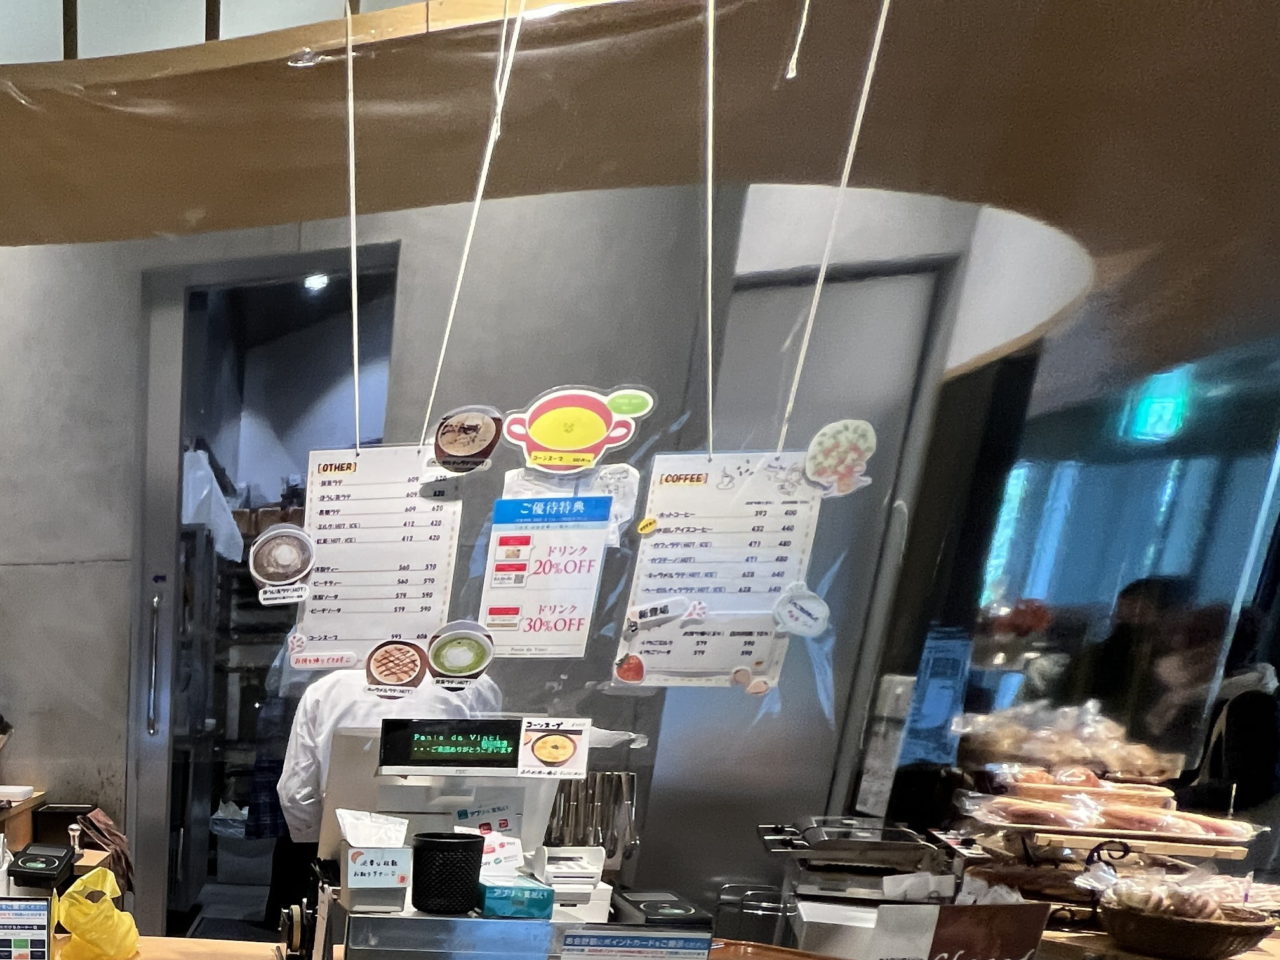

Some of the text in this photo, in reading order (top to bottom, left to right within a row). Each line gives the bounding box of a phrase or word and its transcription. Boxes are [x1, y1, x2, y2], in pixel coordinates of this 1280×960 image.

[520, 501, 584, 515] ご優待特典
[548, 545, 588, 557] ドリンク
[533, 559, 596, 576] 20%OFF
[538, 604, 578, 616] ドリンク
[523, 617, 586, 633] 30%OFF
[526, 721, 564, 730] コーンスープ
